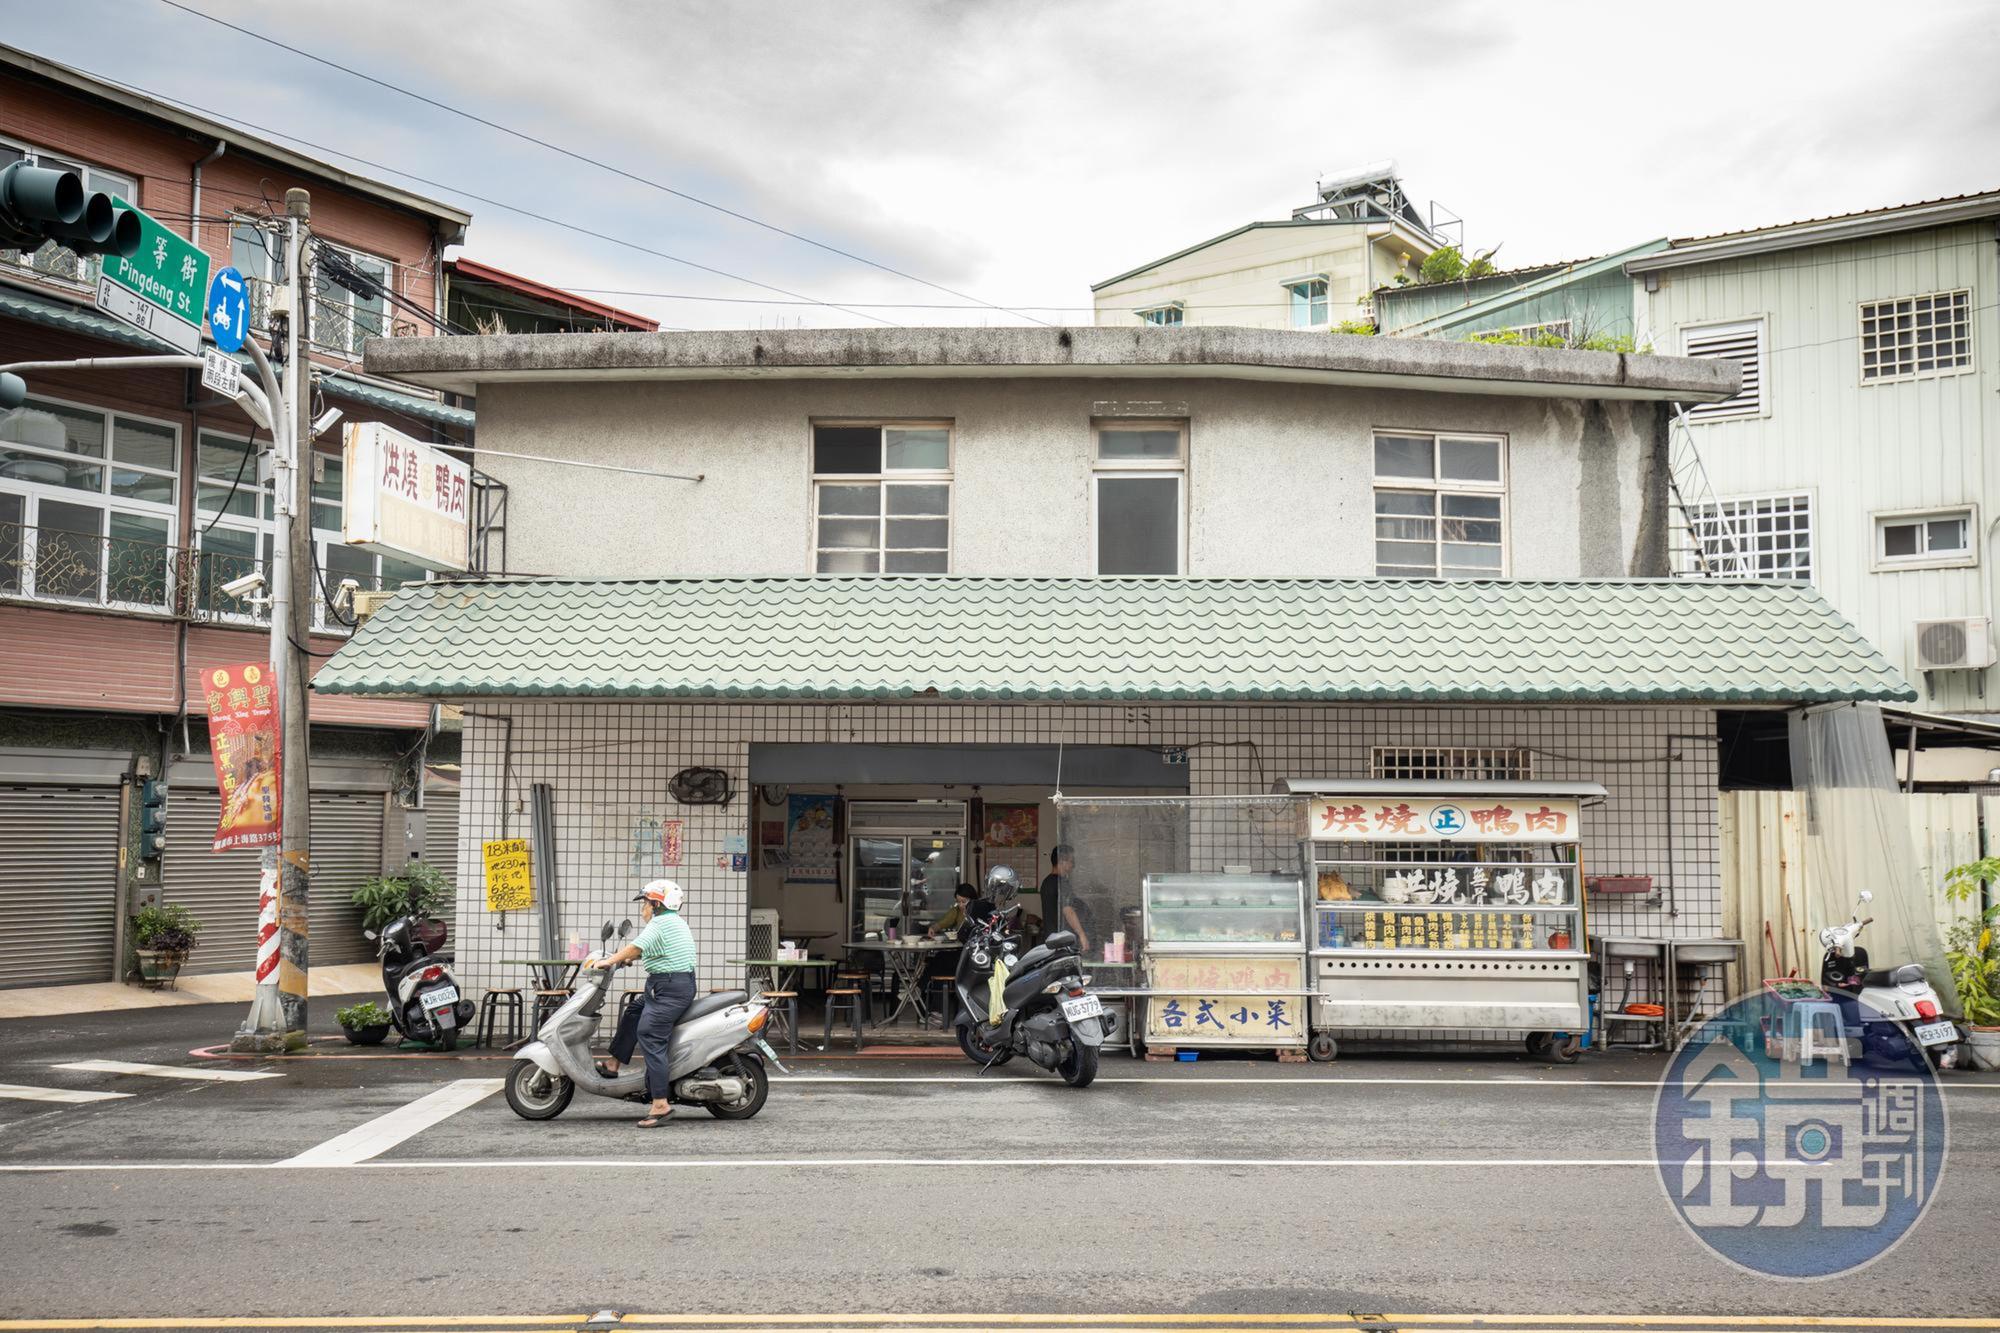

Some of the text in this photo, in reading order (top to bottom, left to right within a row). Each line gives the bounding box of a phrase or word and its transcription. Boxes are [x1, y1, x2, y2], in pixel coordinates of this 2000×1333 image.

[119, 257, 193, 315] Pingdeng St.
[102, 296, 110, 308] N
[235, 710, 250, 719] Xing
[1161, 999, 1292, 1030] 各式小菜
